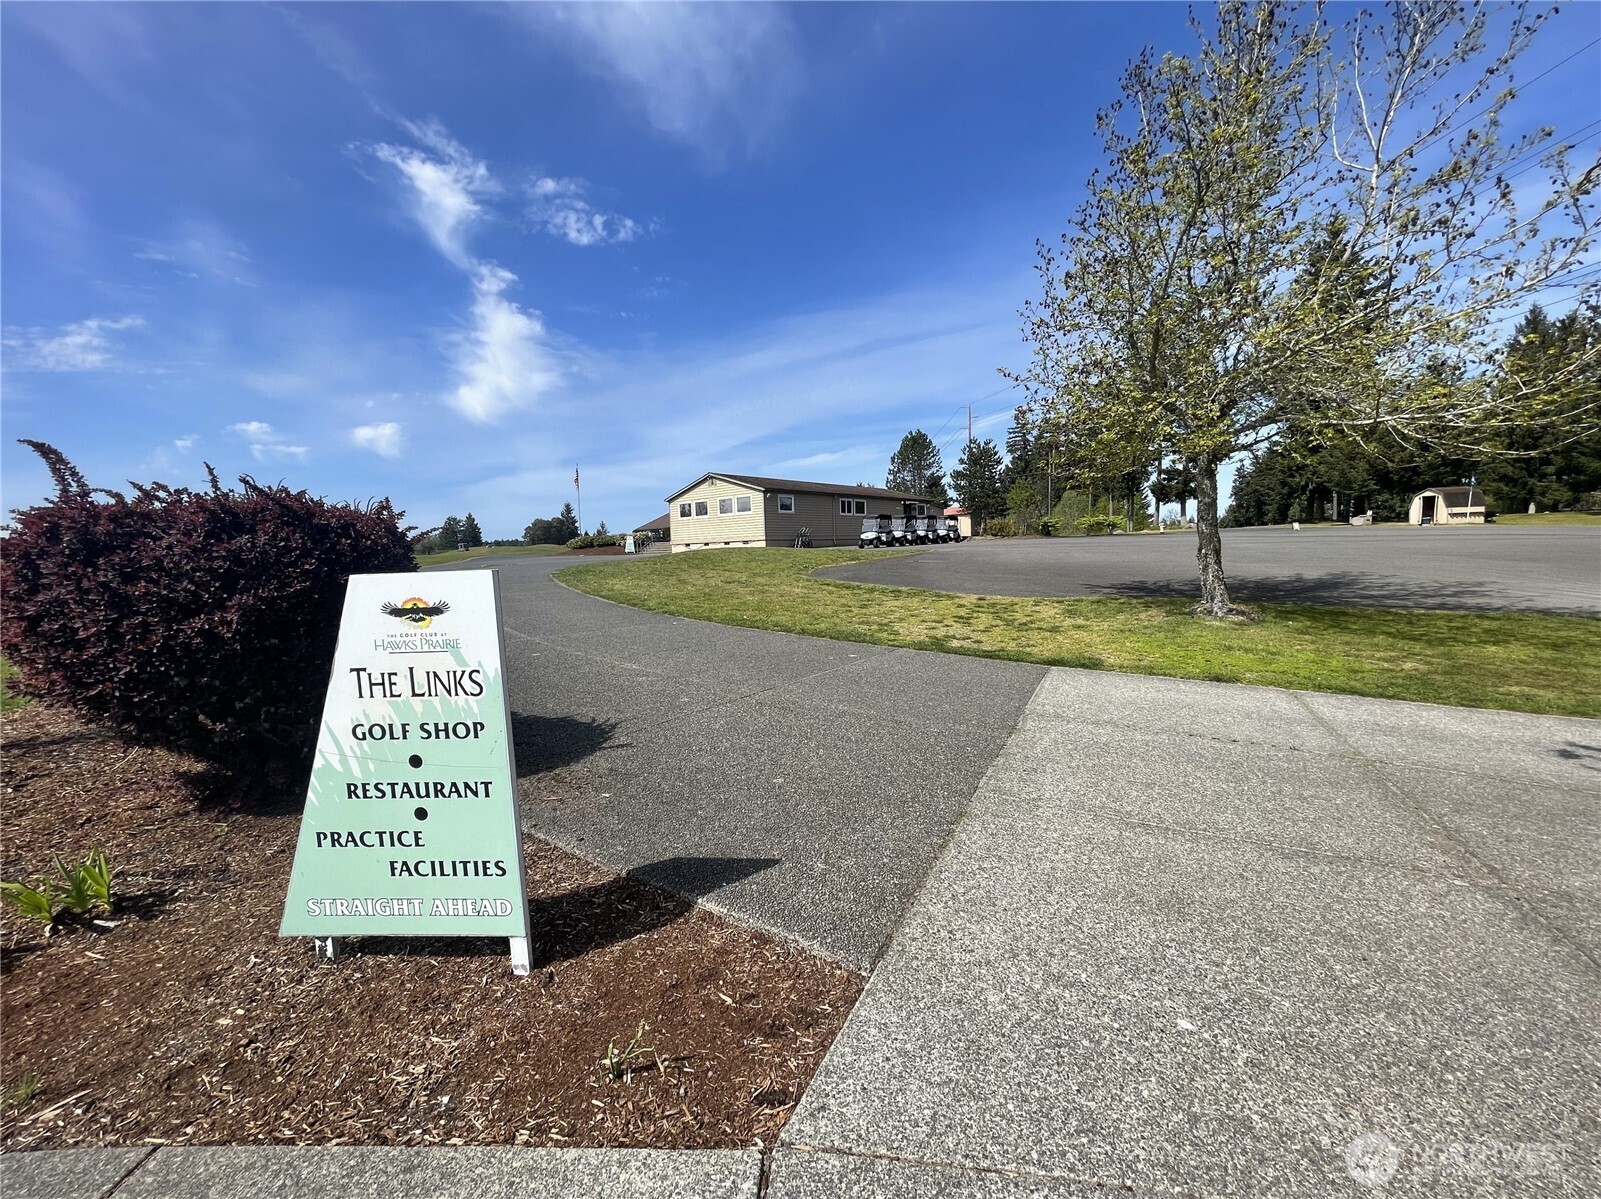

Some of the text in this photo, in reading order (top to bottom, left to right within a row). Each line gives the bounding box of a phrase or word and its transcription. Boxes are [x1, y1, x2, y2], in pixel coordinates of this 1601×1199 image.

[374, 638, 462, 651] HAWKS PRAIRIE
[350, 667, 484, 698] THE LINKS
[351, 721, 485, 741] GOLF SHOP
[346, 781, 492, 799] RESTAURANT
[316, 831, 426, 848] PRACTICE
[389, 860, 507, 877] FACILITIES
[307, 897, 513, 916] STRAIGHT AHEAD
